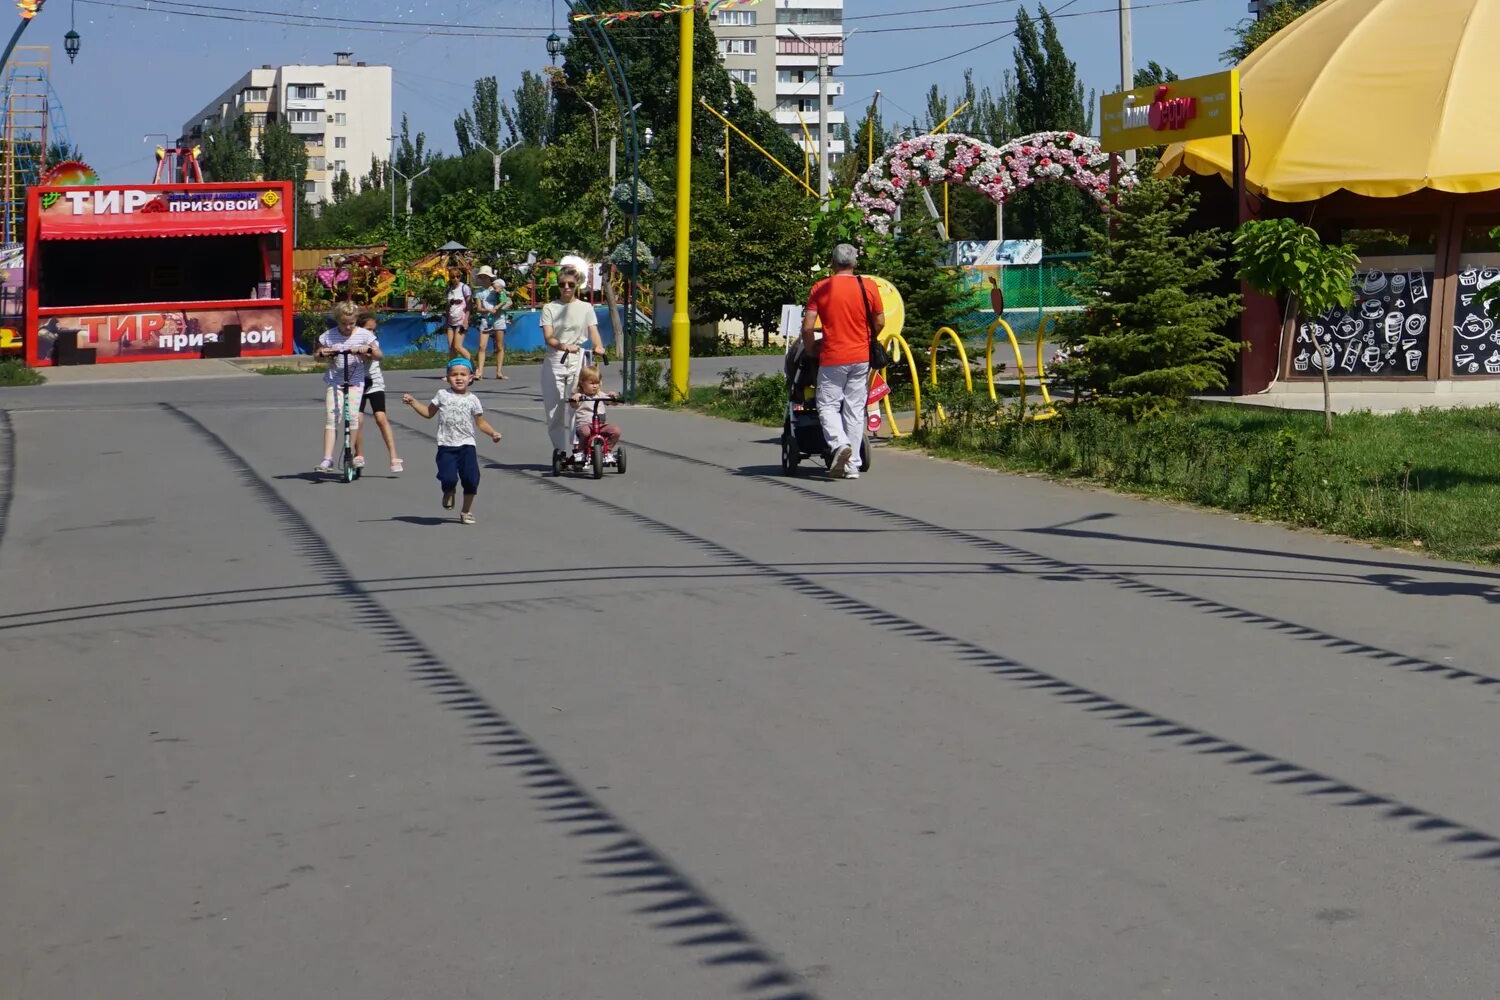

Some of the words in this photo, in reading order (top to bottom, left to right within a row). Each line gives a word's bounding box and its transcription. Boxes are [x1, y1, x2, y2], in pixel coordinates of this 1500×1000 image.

[66, 190, 146, 215] ТИР
[169, 197, 259, 212] ПРИЗОВОЙ
[79, 313, 166, 344] ТИР
[158, 326, 276, 352] призой
